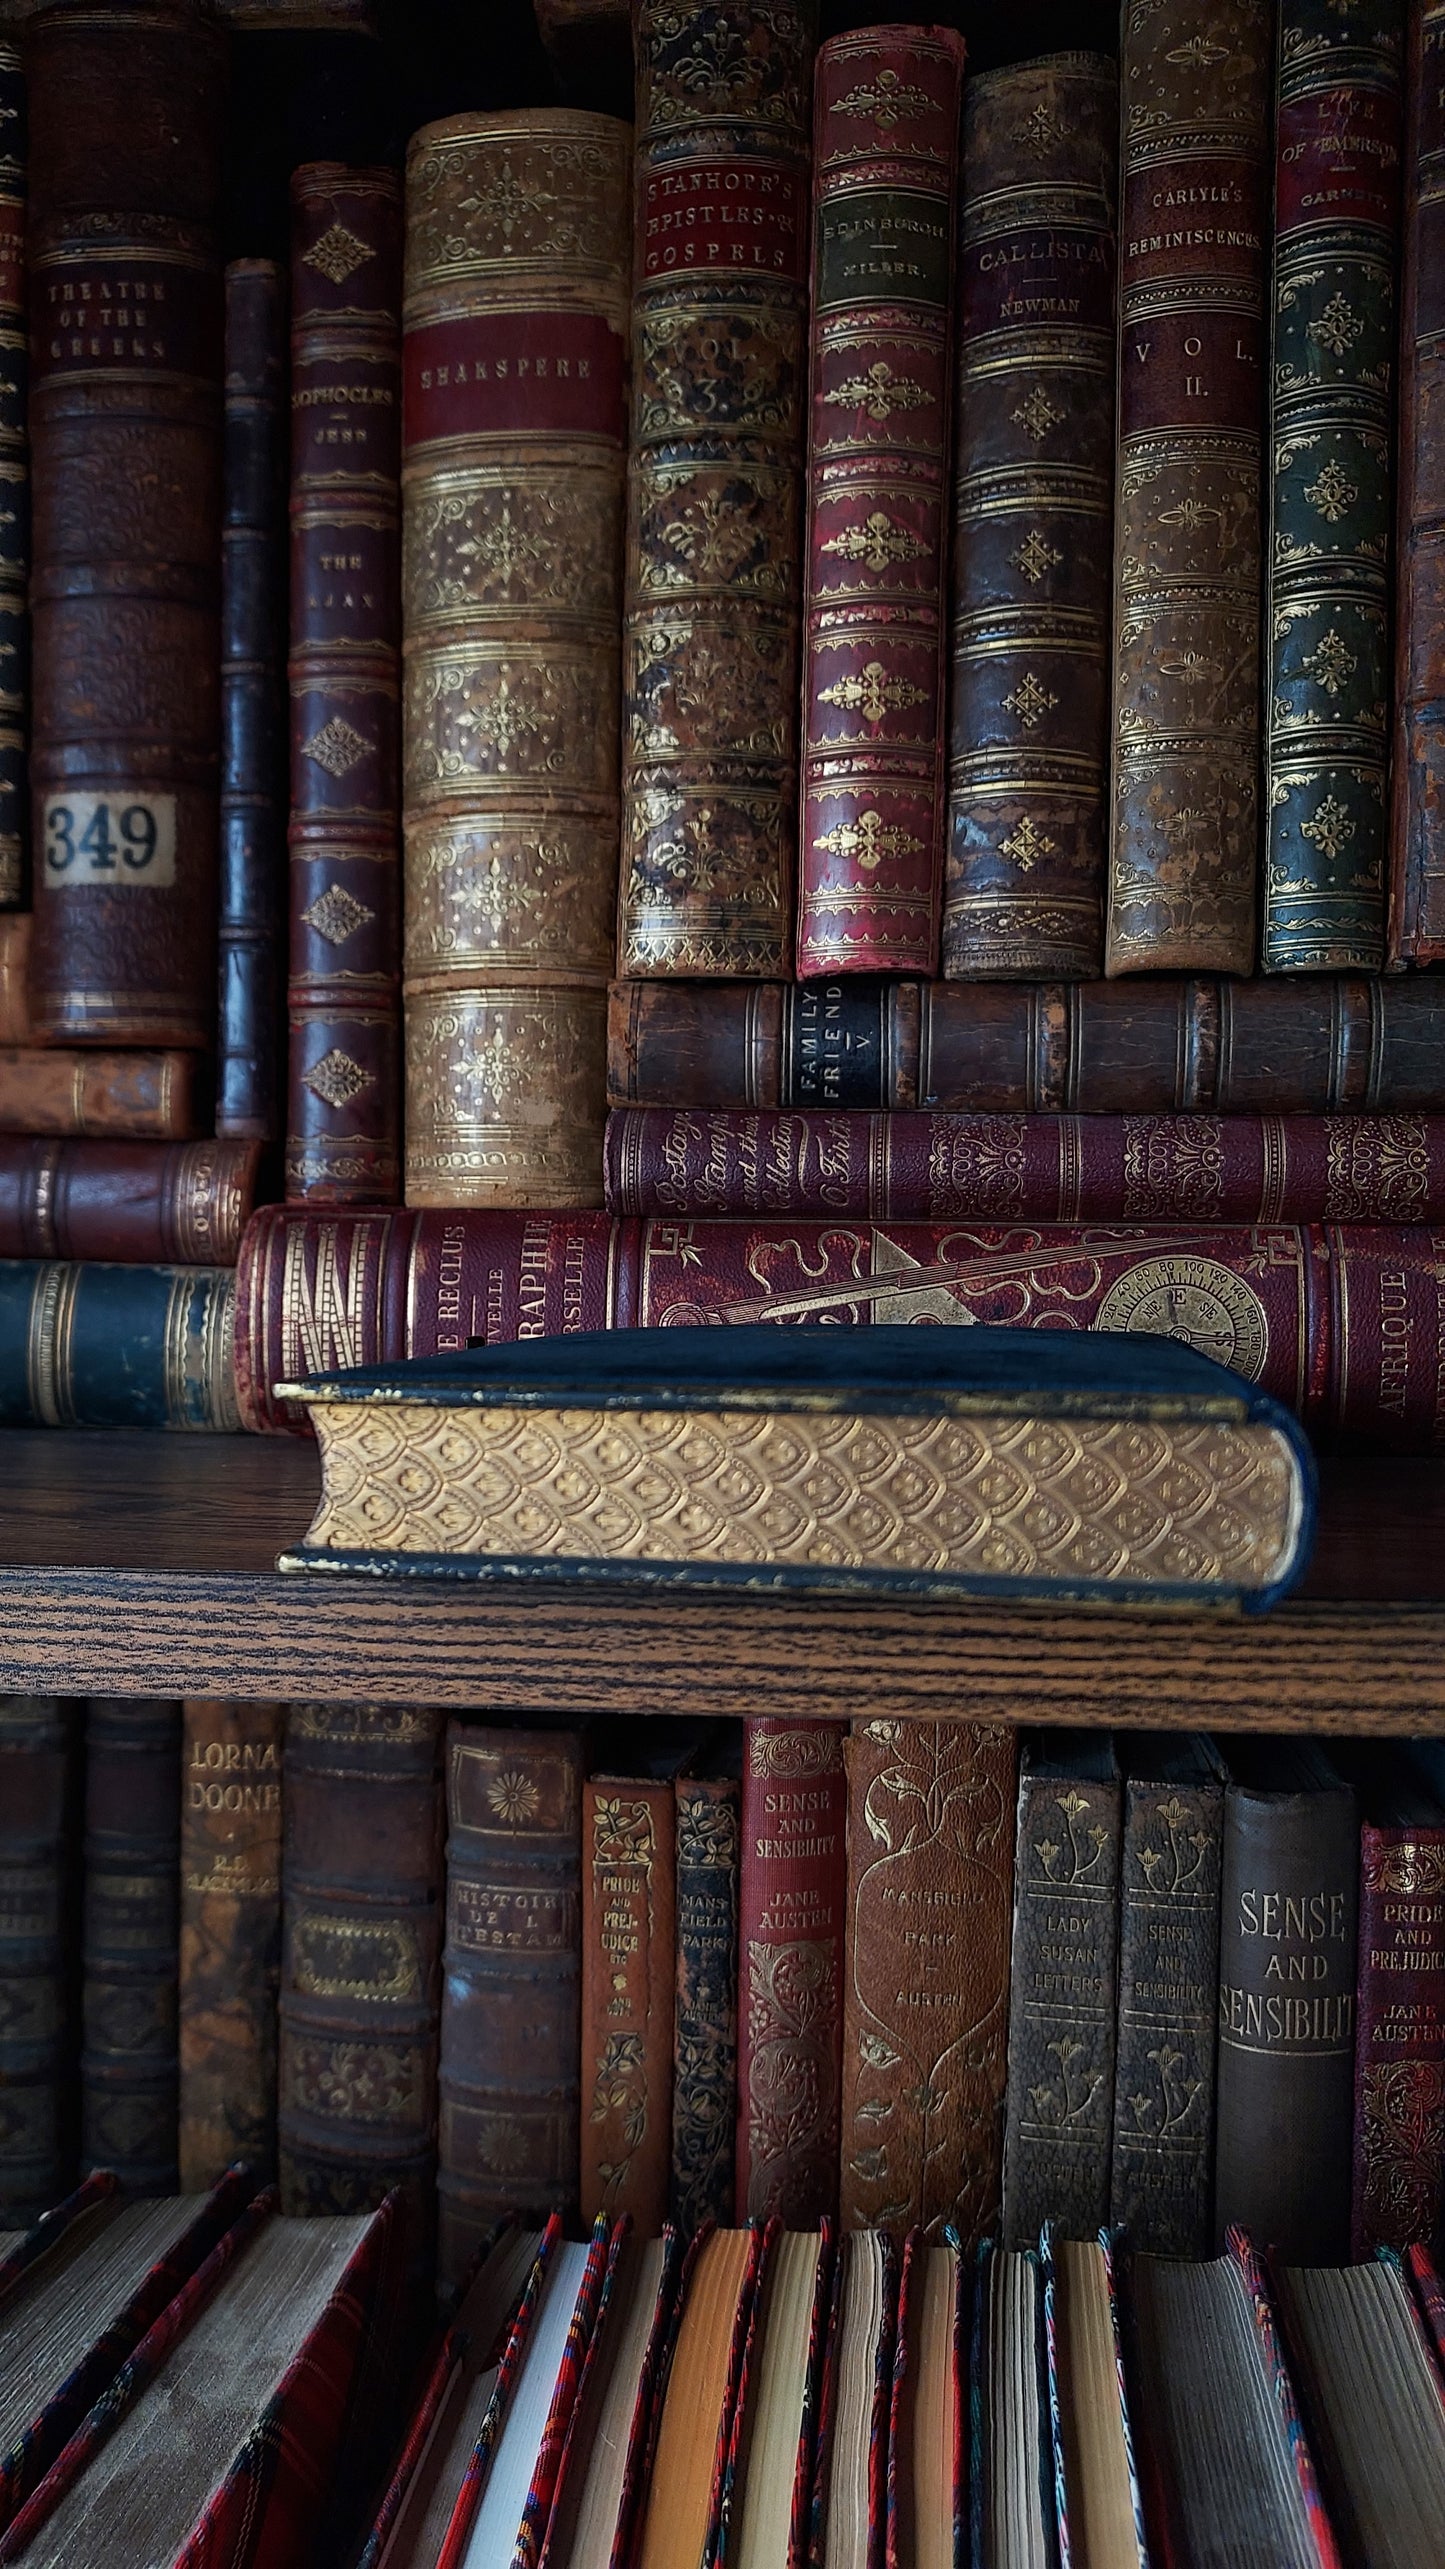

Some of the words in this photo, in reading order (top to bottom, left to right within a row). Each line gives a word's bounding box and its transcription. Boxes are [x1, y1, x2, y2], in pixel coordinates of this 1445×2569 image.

[1281, 142, 1307, 164] OF
[647, 171, 793, 202] STANHOPE'S
[1152, 181, 1243, 208] CARLYLE'S
[777, 214, 795, 234] &
[646, 243, 786, 270] GOSPELS
[979, 242, 1103, 271] CALLISTA
[48, 281, 165, 303] THEATRE
[1000, 297, 1081, 318] NEWMAN
[60, 310, 87, 328] OF
[100, 309, 147, 328] THE
[51, 338, 165, 359] GREEKS
[420, 356, 591, 390] SHAKSPERE
[291, 386, 393, 409] SOPHOCLES
[320, 555, 362, 571] THE
[308, 593, 376, 609] AJAX
[47, 803, 159, 872] 349
[800, 991, 819, 1090] FAMILY
[823, 986, 843, 1099] FRIEND
[654, 1111, 702, 1211] Postage
[761, 1116, 793, 1209] Collection
[738, 1162, 759, 1210] and
[438, 1225, 466, 1321] RECLUS
[1158, 1261, 1175, 1272] 80
[1184, 1261, 1205, 1273] 100
[1209, 1268, 1228, 1284] 120
[1117, 1281, 1131, 1298] 40
[1172, 1287, 1187, 1304] E
[1230, 1282, 1247, 1301] 140
[1104, 1303, 1118, 1319] 20
[1244, 1304, 1259, 1325] 160
[1249, 1331, 1262, 1351] 180
[1378, 1271, 1414, 1418] AFRIQUE
[188, 1741, 281, 1771] LORNA
[188, 1782, 281, 1814] DOONE
[764, 1790, 831, 1814] SENSE
[777, 1818, 816, 1834] AND
[755, 1834, 838, 1859] SENSIBILITY
[602, 1876, 640, 1894] PRIDE
[769, 1889, 820, 1908] JANE
[680, 1912, 726, 1929] FIELD
[759, 1907, 832, 1930] AUSTEN
[1238, 1888, 1346, 1943] SENSE
[1383, 1903, 1443, 1923] PRIDE
[1046, 1915, 1091, 1933] LADY
[1148, 1924, 1193, 1942] SENSE
[601, 1933, 639, 1952] UDICE
[904, 1930, 957, 1946] PARK
[1394, 1928, 1433, 1946] AND
[1040, 1945, 1098, 1964] SUSAN
[1155, 1956, 1184, 1971] AND
[1264, 1954, 1329, 1981] AND
[1033, 1973, 1104, 1993] LETTERS
[1135, 1981, 1204, 2001] SENSIBILITY
[1383, 2003, 1438, 2020] JANE
[1372, 2023, 1445, 2042] AUSTEN
